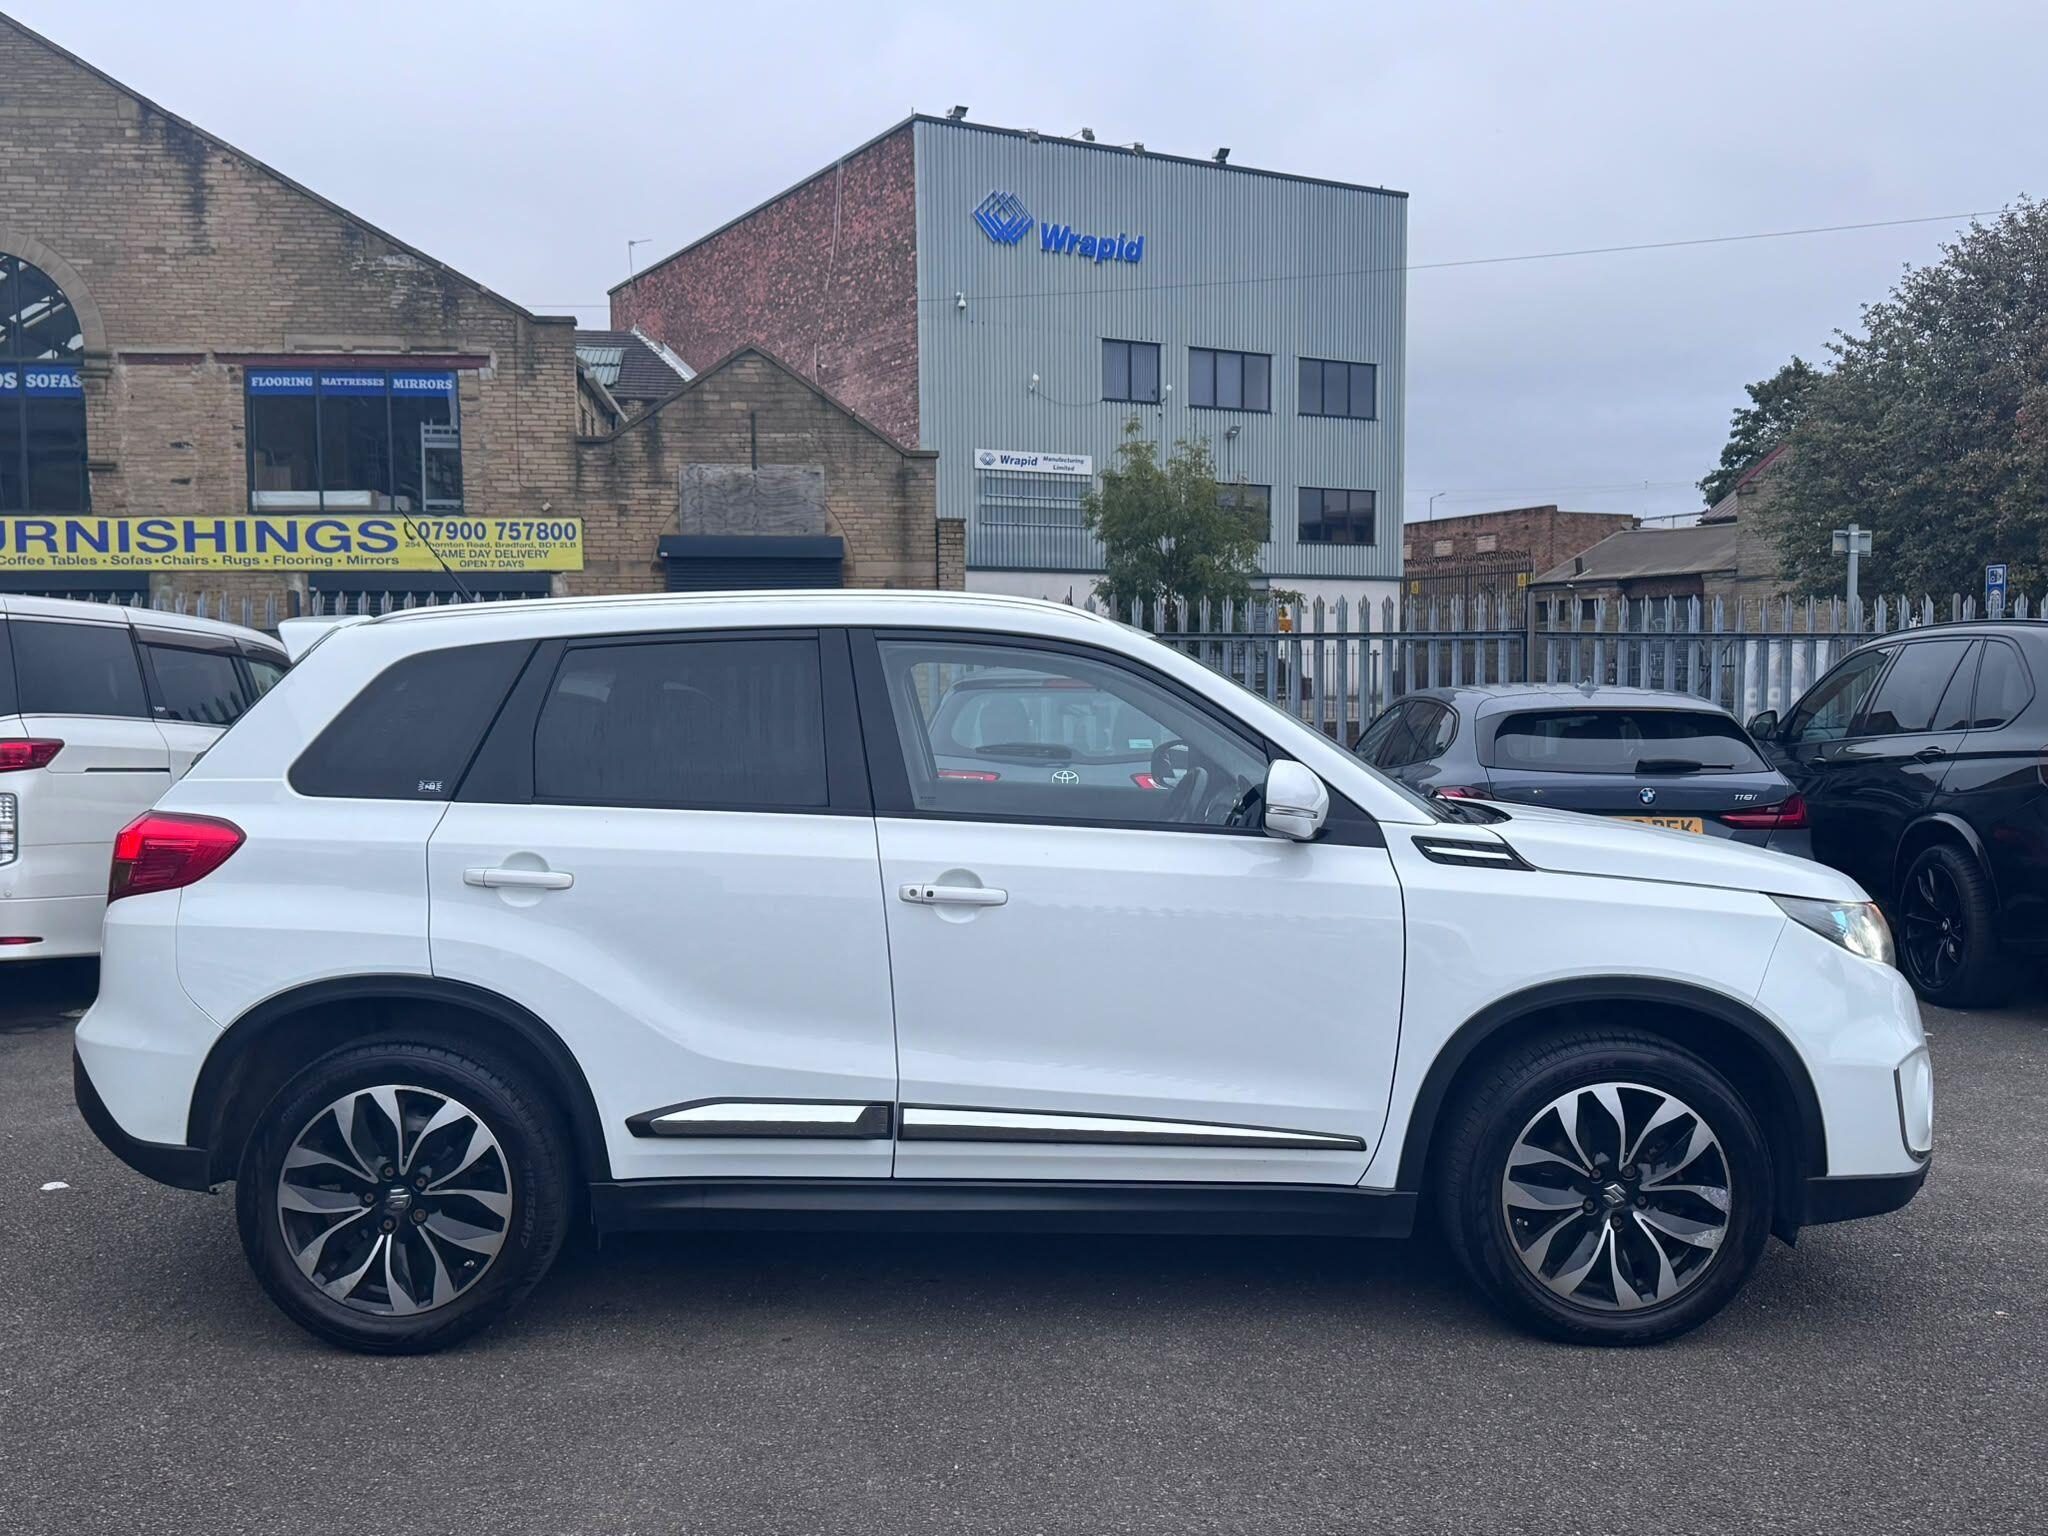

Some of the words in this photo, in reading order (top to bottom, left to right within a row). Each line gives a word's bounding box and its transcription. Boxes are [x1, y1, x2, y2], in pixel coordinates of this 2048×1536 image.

[1040, 221, 1144, 264] Wrapid
[25, 374, 82, 388] SOFAS
[251, 377, 313, 387] FLOORING
[321, 378, 384, 387] MATTRESSES
[393, 379, 453, 390] MIRRORS
[1000, 455, 1038, 467] Wrapid
[1043, 456, 1084, 464] Manufacturing
[0, 520, 399, 553] RNISHINGS
[417, 522, 487, 541] 07900
[495, 522, 577, 541] 757800
[433, 550, 465, 558] SAME
[469, 550, 491, 558] DAY
[495, 550, 549, 558] DELIVERY
[50, 555, 97, 566] Tables
[110, 555, 152, 566] Sofas
[161, 555, 209, 566] Chairs
[223, 555, 260, 568] Rugs
[273, 555, 333, 568] Flooring
[347, 555, 399, 566] Mirrors
[459, 560, 488, 568] OPEN
[498, 560, 524, 568] DAYS
